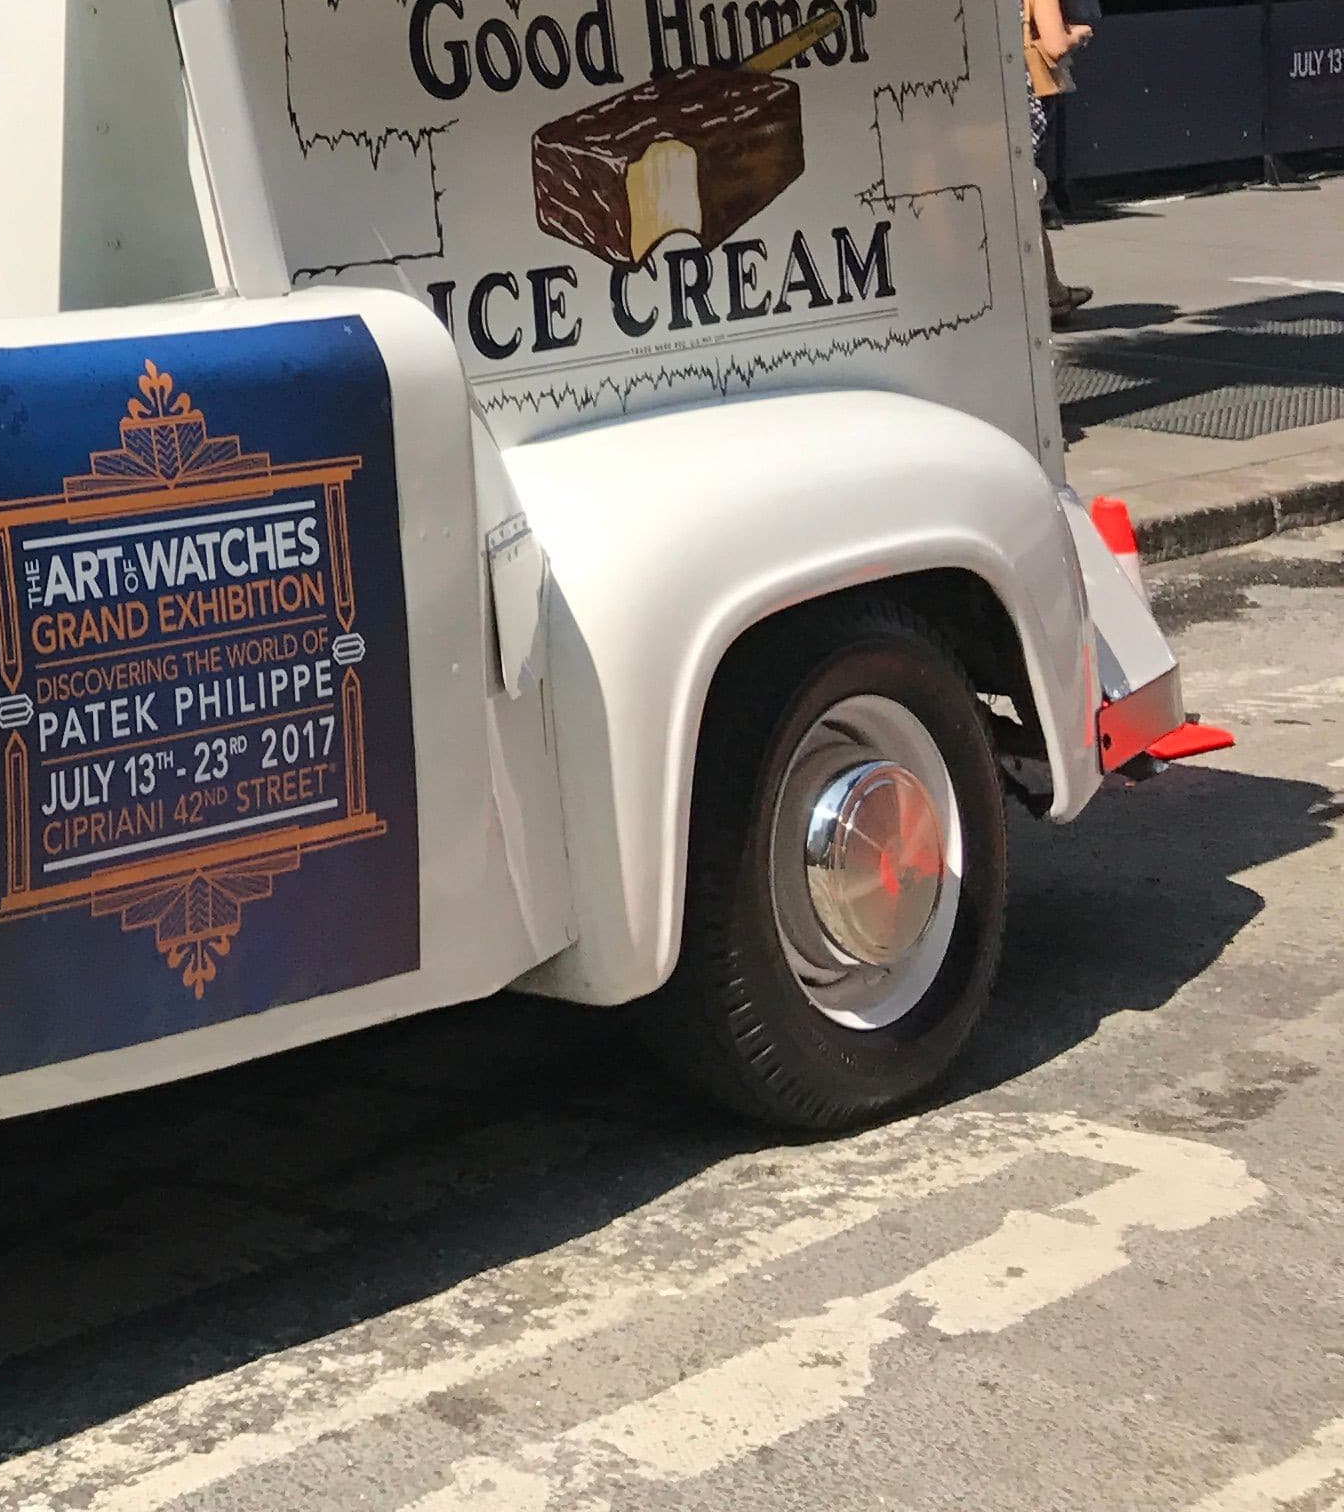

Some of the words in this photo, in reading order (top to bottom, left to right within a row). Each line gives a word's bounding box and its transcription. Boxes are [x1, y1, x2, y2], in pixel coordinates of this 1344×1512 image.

[1290, 49, 1324, 78] JULY
[610, 221, 897, 337] CREAM
[24, 558, 43, 609] THE
[43, 545, 123, 608] ART
[122, 558, 139, 593] OF
[135, 516, 321, 590] WATCHES
[31, 600, 148, 655] GRAND
[157, 571, 326, 633] EXHIBITION
[36, 655, 179, 704] DISCOVERING
[182, 646, 223, 676] THE
[226, 635, 298, 668] WORLD
[302, 626, 328, 655] OF
[39, 691, 158, 752] PATEK
[174, 660, 334, 726] PHILIPPE
[41, 759, 115, 816] JULY
[261, 715, 335, 769] 2017
[42, 799, 163, 855] CIPRIANI
[236, 763, 328, 813] STREET
